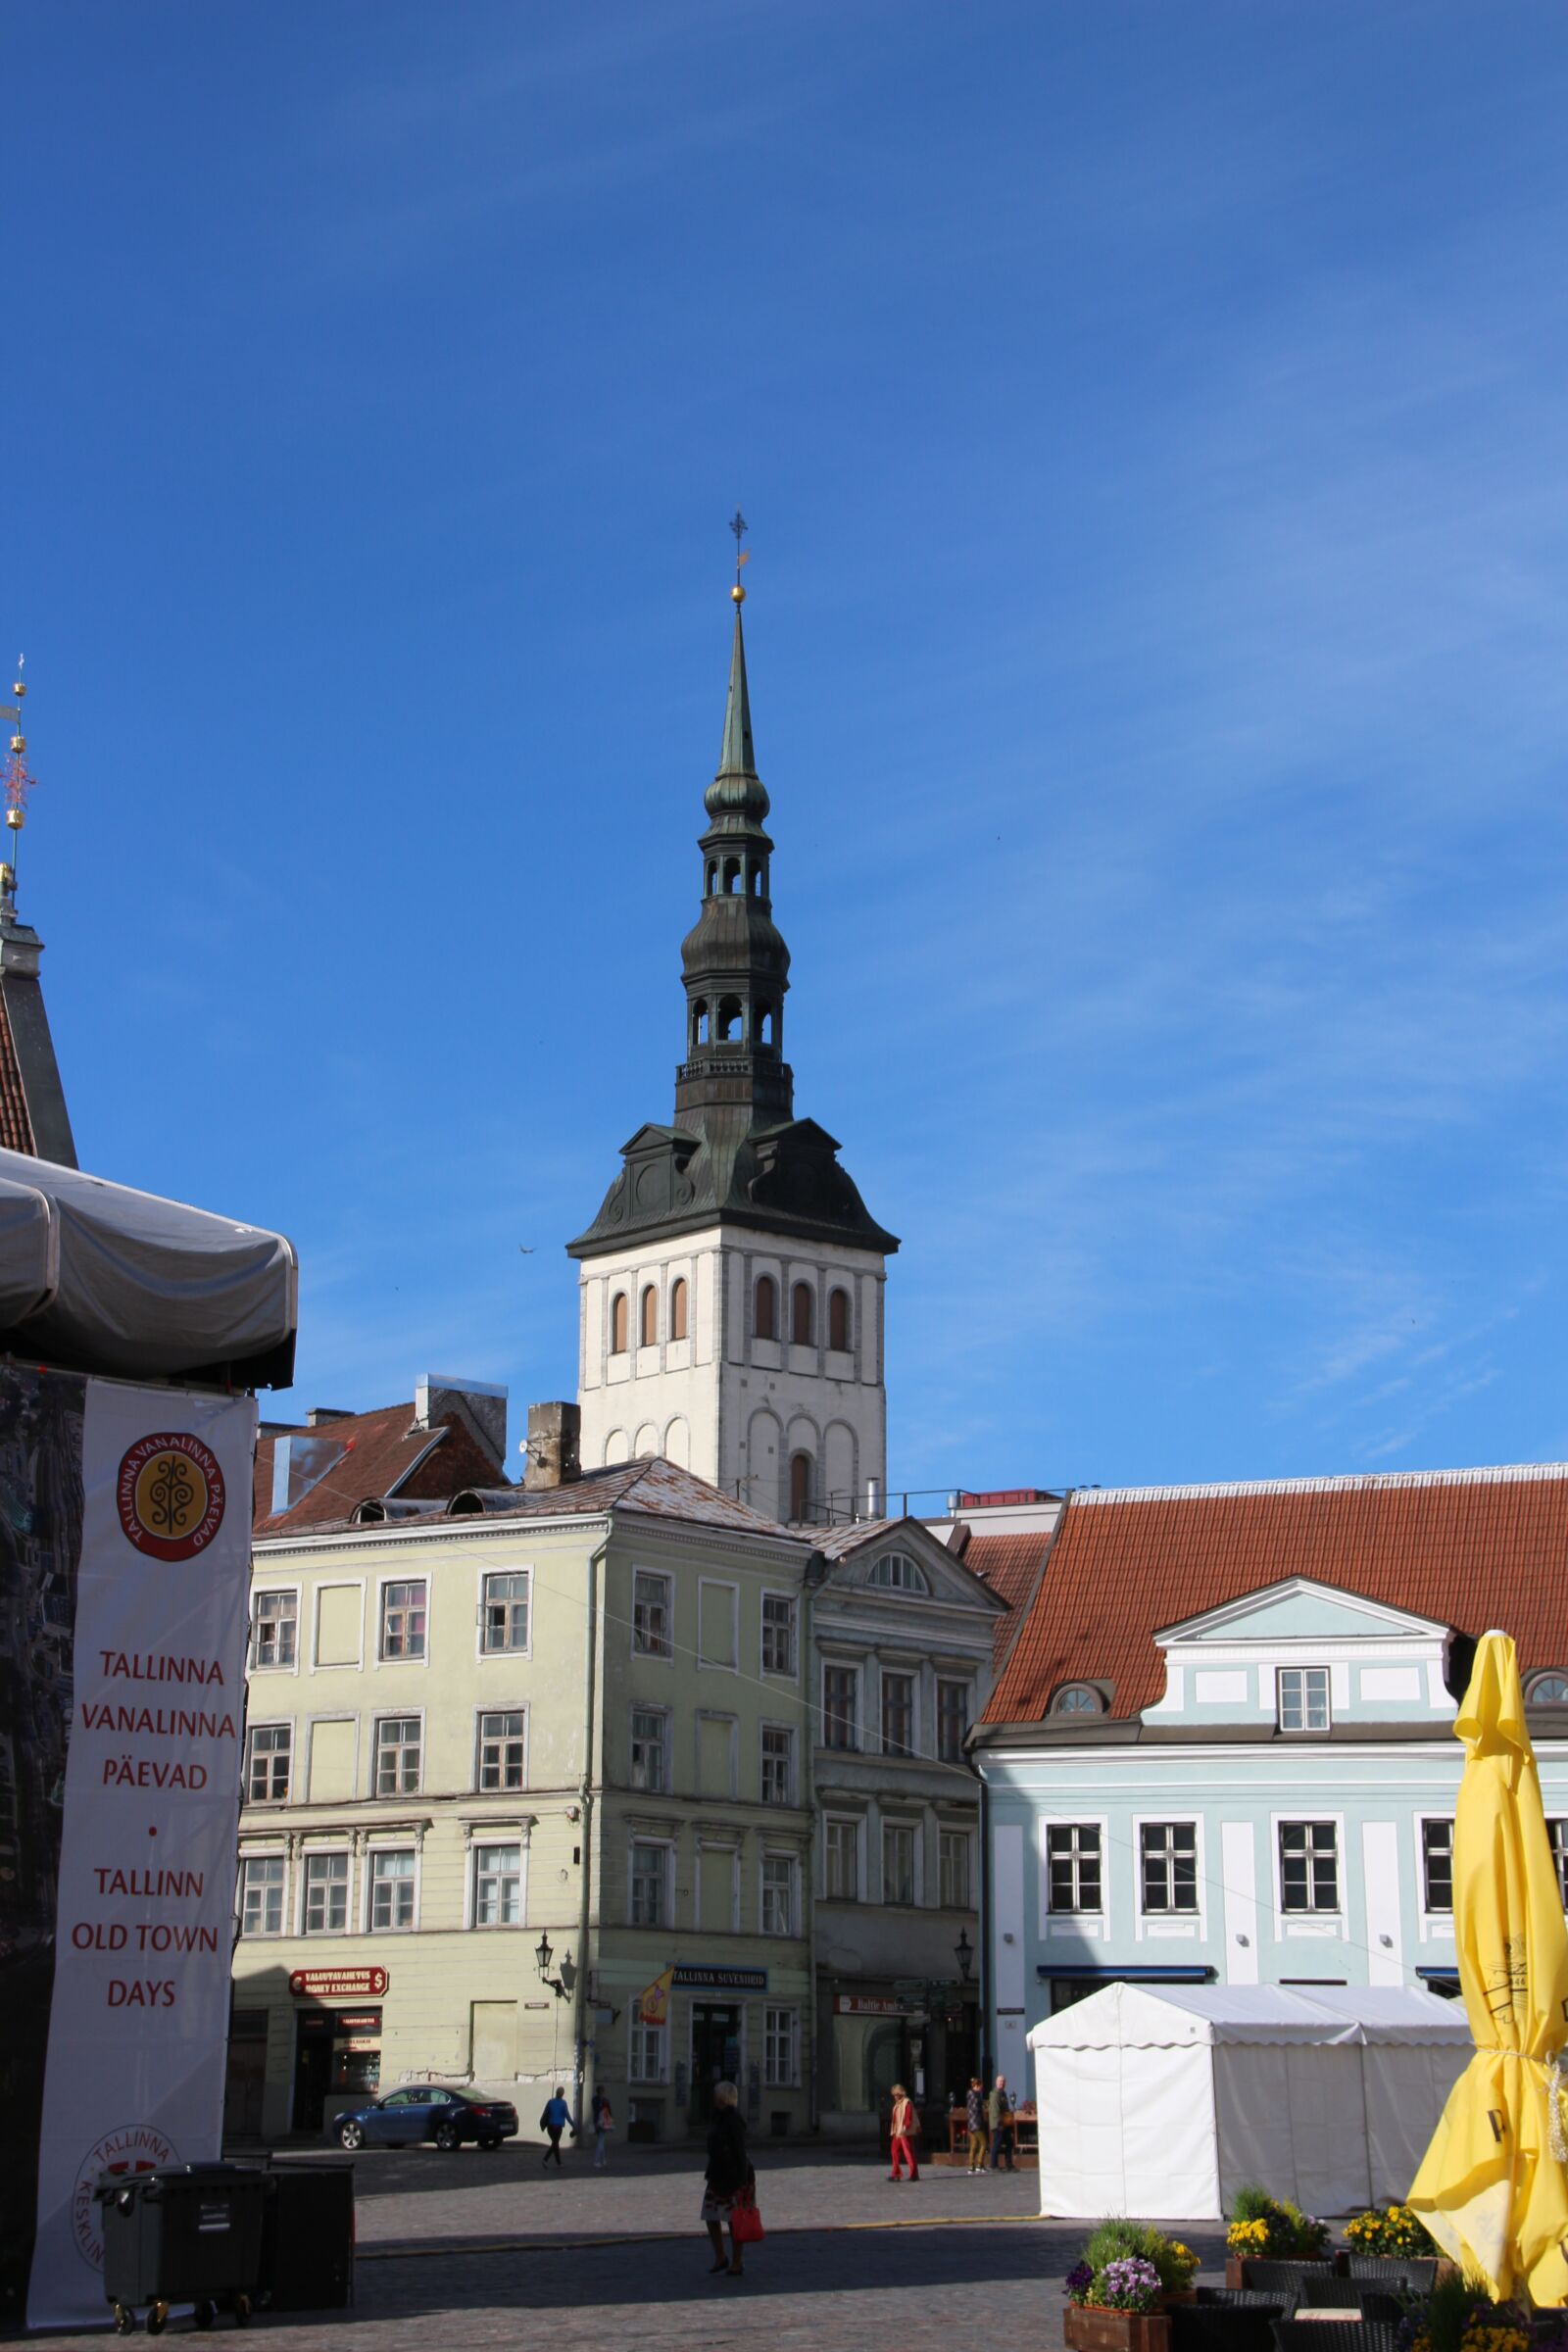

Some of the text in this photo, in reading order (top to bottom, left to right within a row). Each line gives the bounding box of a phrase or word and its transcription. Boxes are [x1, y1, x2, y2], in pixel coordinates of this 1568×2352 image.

[122, 1437, 223, 1546] TALLINNA VANALINNA PÄEVAD
[100, 1650, 224, 1686] TALLINNA
[81, 1702, 236, 1739] VANALINNA
[102, 1754, 208, 1789] PÄEVAD
[94, 1868, 204, 1897] TALLINN
[72, 1922, 219, 1952] OLD TOWN
[108, 1980, 175, 2007] DAYS
[331, 1983, 370, 1992] EXCHANGE
[94, 2132, 170, 2163] TALLINNA
